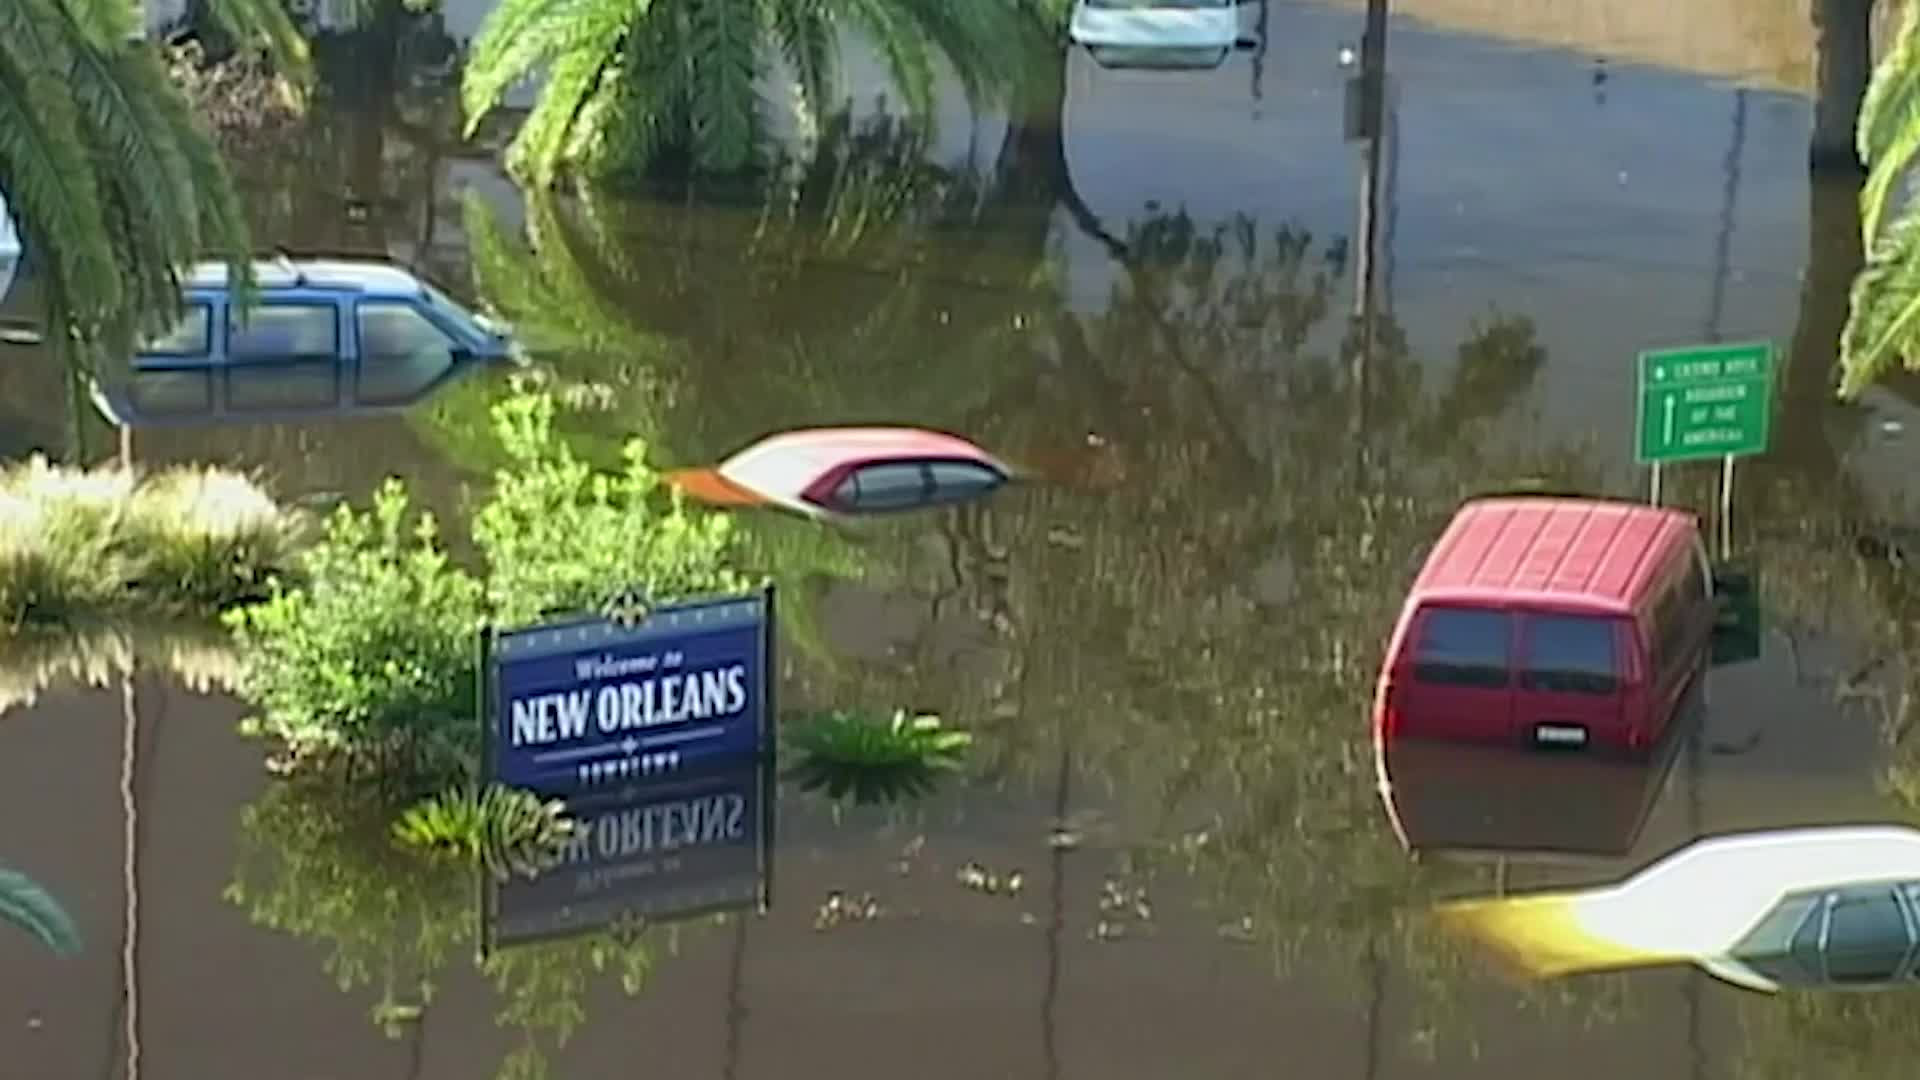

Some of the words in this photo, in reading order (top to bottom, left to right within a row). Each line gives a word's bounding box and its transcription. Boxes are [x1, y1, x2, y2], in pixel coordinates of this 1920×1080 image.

[574, 651, 658, 680] Welcome
[662, 650, 684, 669] to
[511, 688, 591, 746] NEW
[598, 664, 746, 734] ORLEANS
